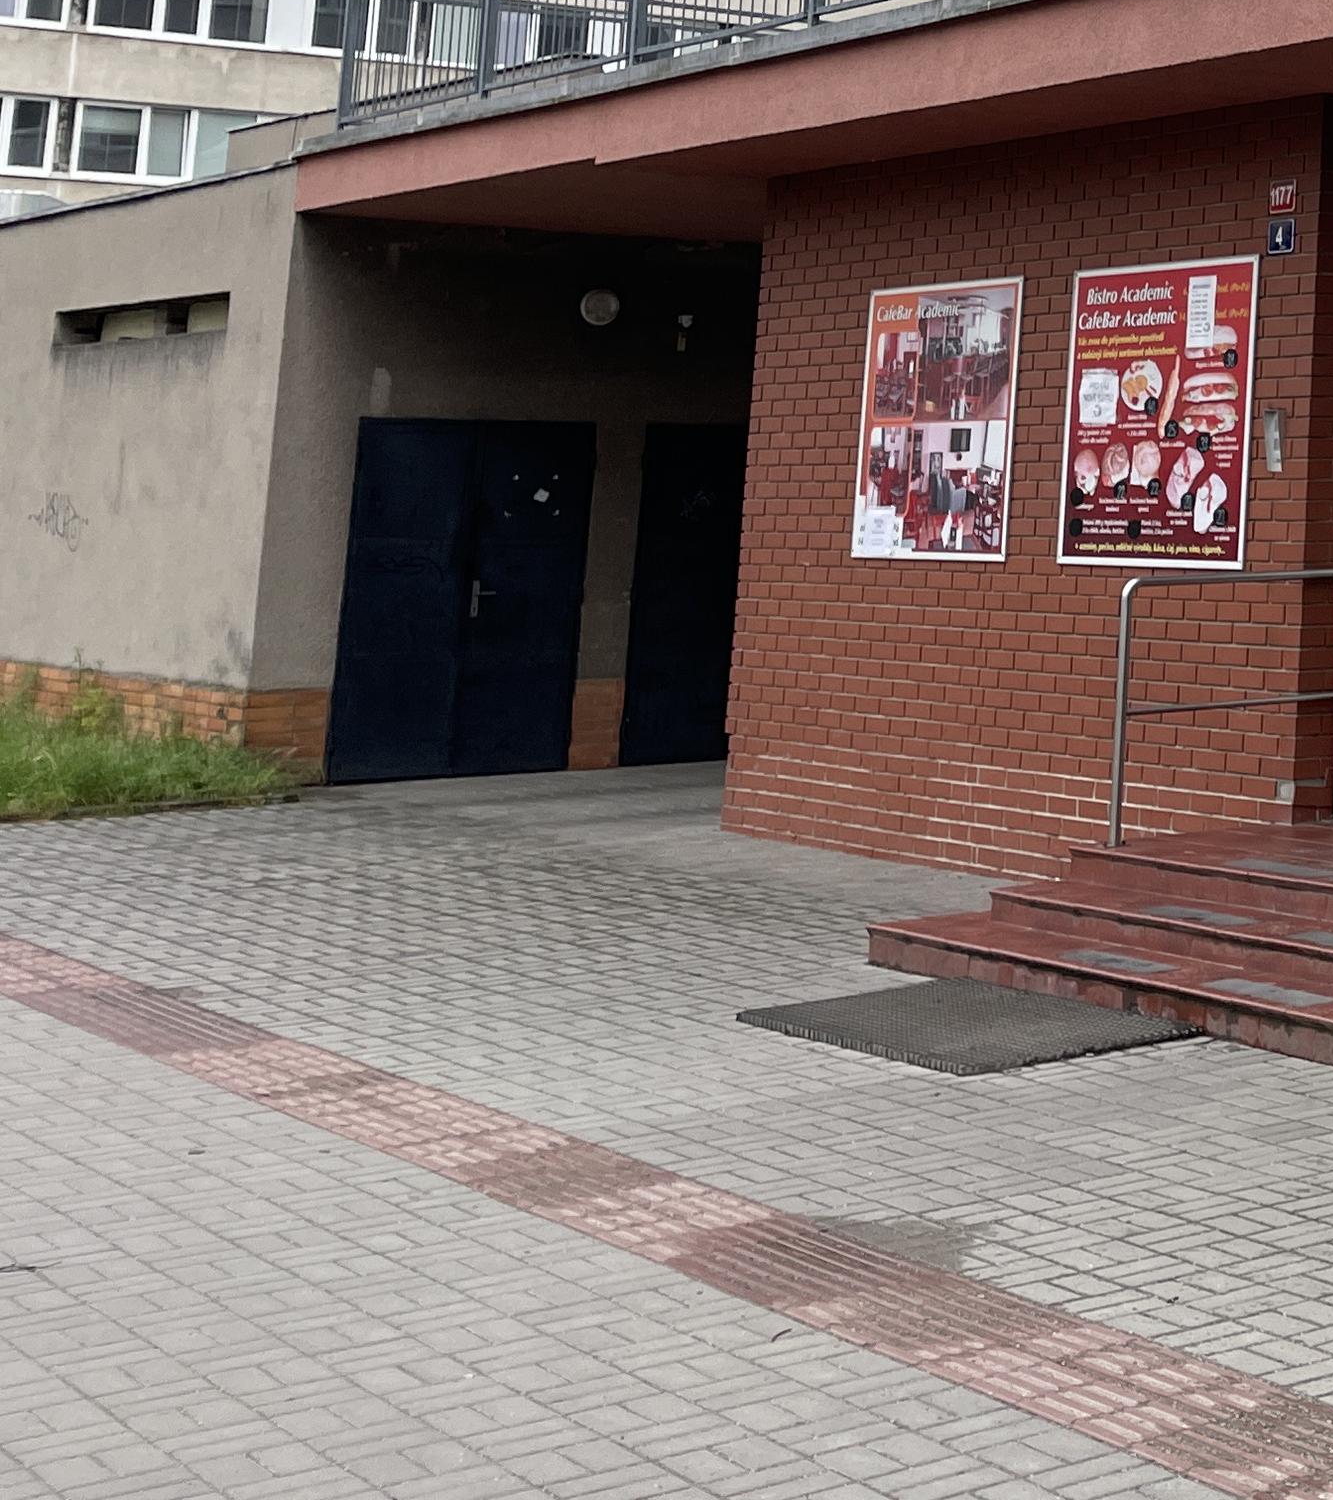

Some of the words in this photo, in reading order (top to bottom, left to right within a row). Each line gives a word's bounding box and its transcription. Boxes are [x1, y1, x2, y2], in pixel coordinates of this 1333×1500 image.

[1270, 185, 1293, 207] 1177
[1275, 226, 1283, 247] 4
[1086, 287, 1118, 306] Bistro
[1119, 280, 1175, 304] Academic
[877, 304, 913, 322] CafeBar
[914, 298, 961, 319] Academic
[1078, 310, 1121, 330] CafeBar
[1122, 305, 1178, 327] Academic
